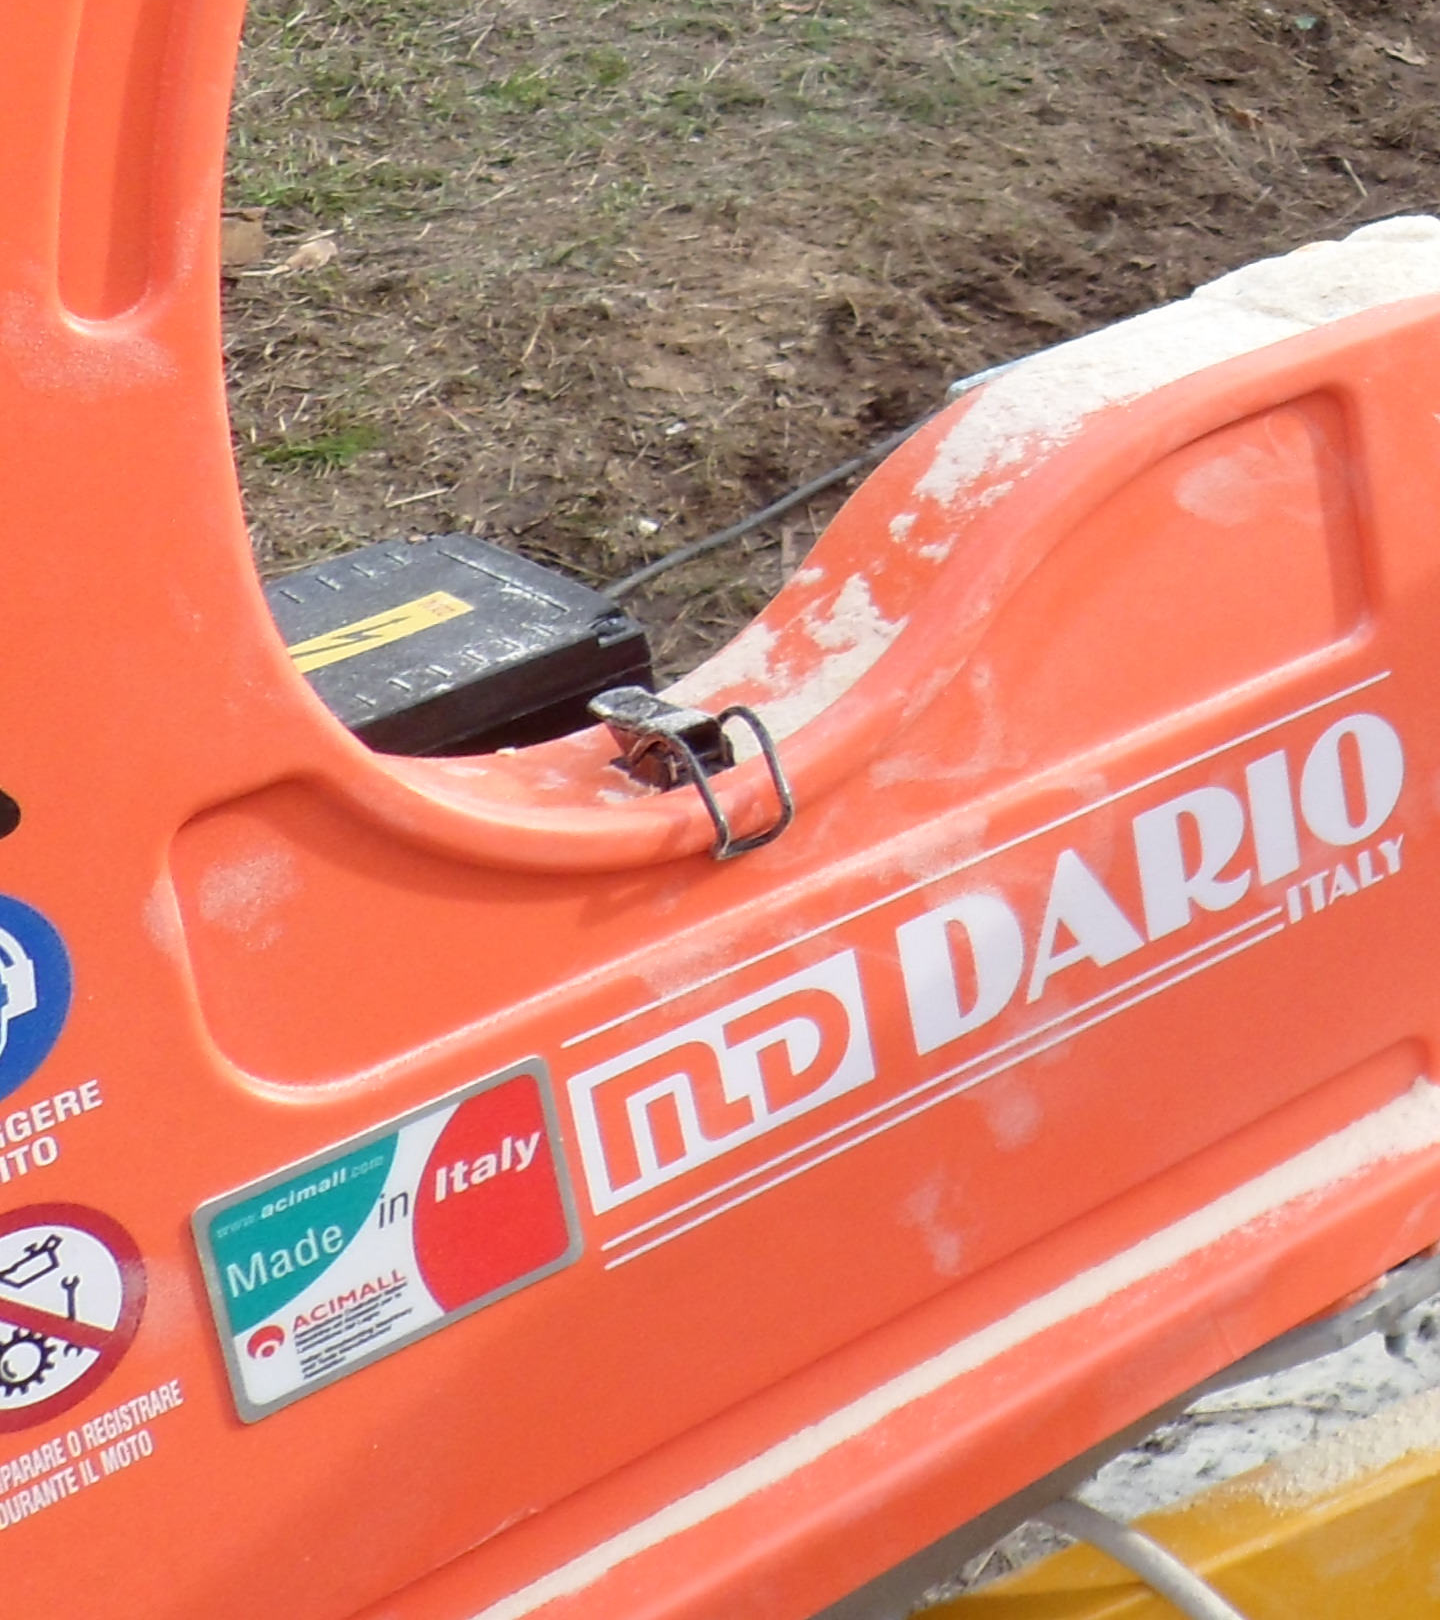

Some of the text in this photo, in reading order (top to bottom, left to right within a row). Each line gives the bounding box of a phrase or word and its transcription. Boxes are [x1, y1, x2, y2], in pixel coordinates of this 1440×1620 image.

[896, 713, 1404, 1056] DARIO
[1286, 833, 1404, 924] ITALY
[0, 1079, 103, 1149] GERE
[226, 1131, 541, 1298] Made in Italy
[293, 1268, 407, 1333] ACIMALL
[0, 1379, 183, 1496] PARARE O REGISTRARE
[79, 1458, 100, 1486] IL
[100, 1430, 153, 1476] MOTO
